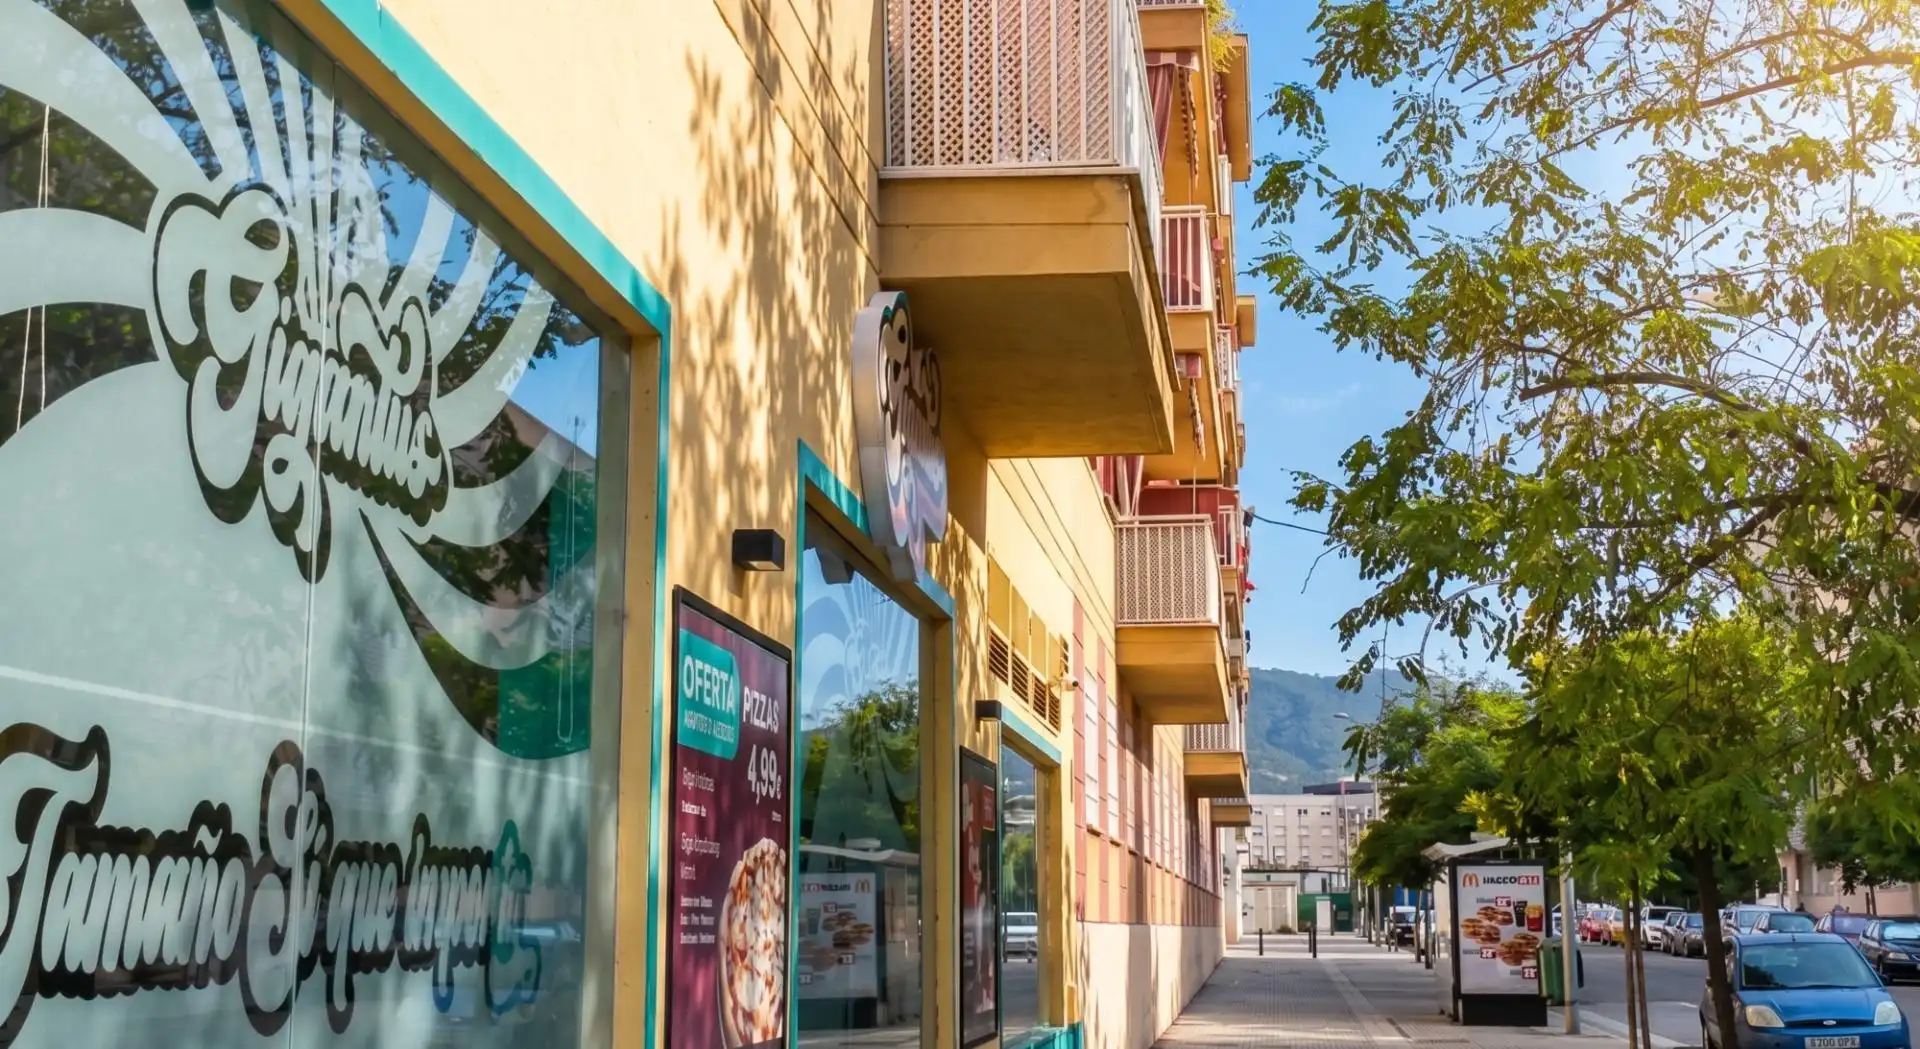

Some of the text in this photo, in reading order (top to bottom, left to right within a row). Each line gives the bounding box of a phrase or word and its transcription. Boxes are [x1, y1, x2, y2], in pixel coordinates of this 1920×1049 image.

[682, 654, 736, 716] OFERTA
[742, 685, 780, 734] PIZZAS
[747, 743, 782, 805] 4,99€
[326, 846, 401, 1023] que
